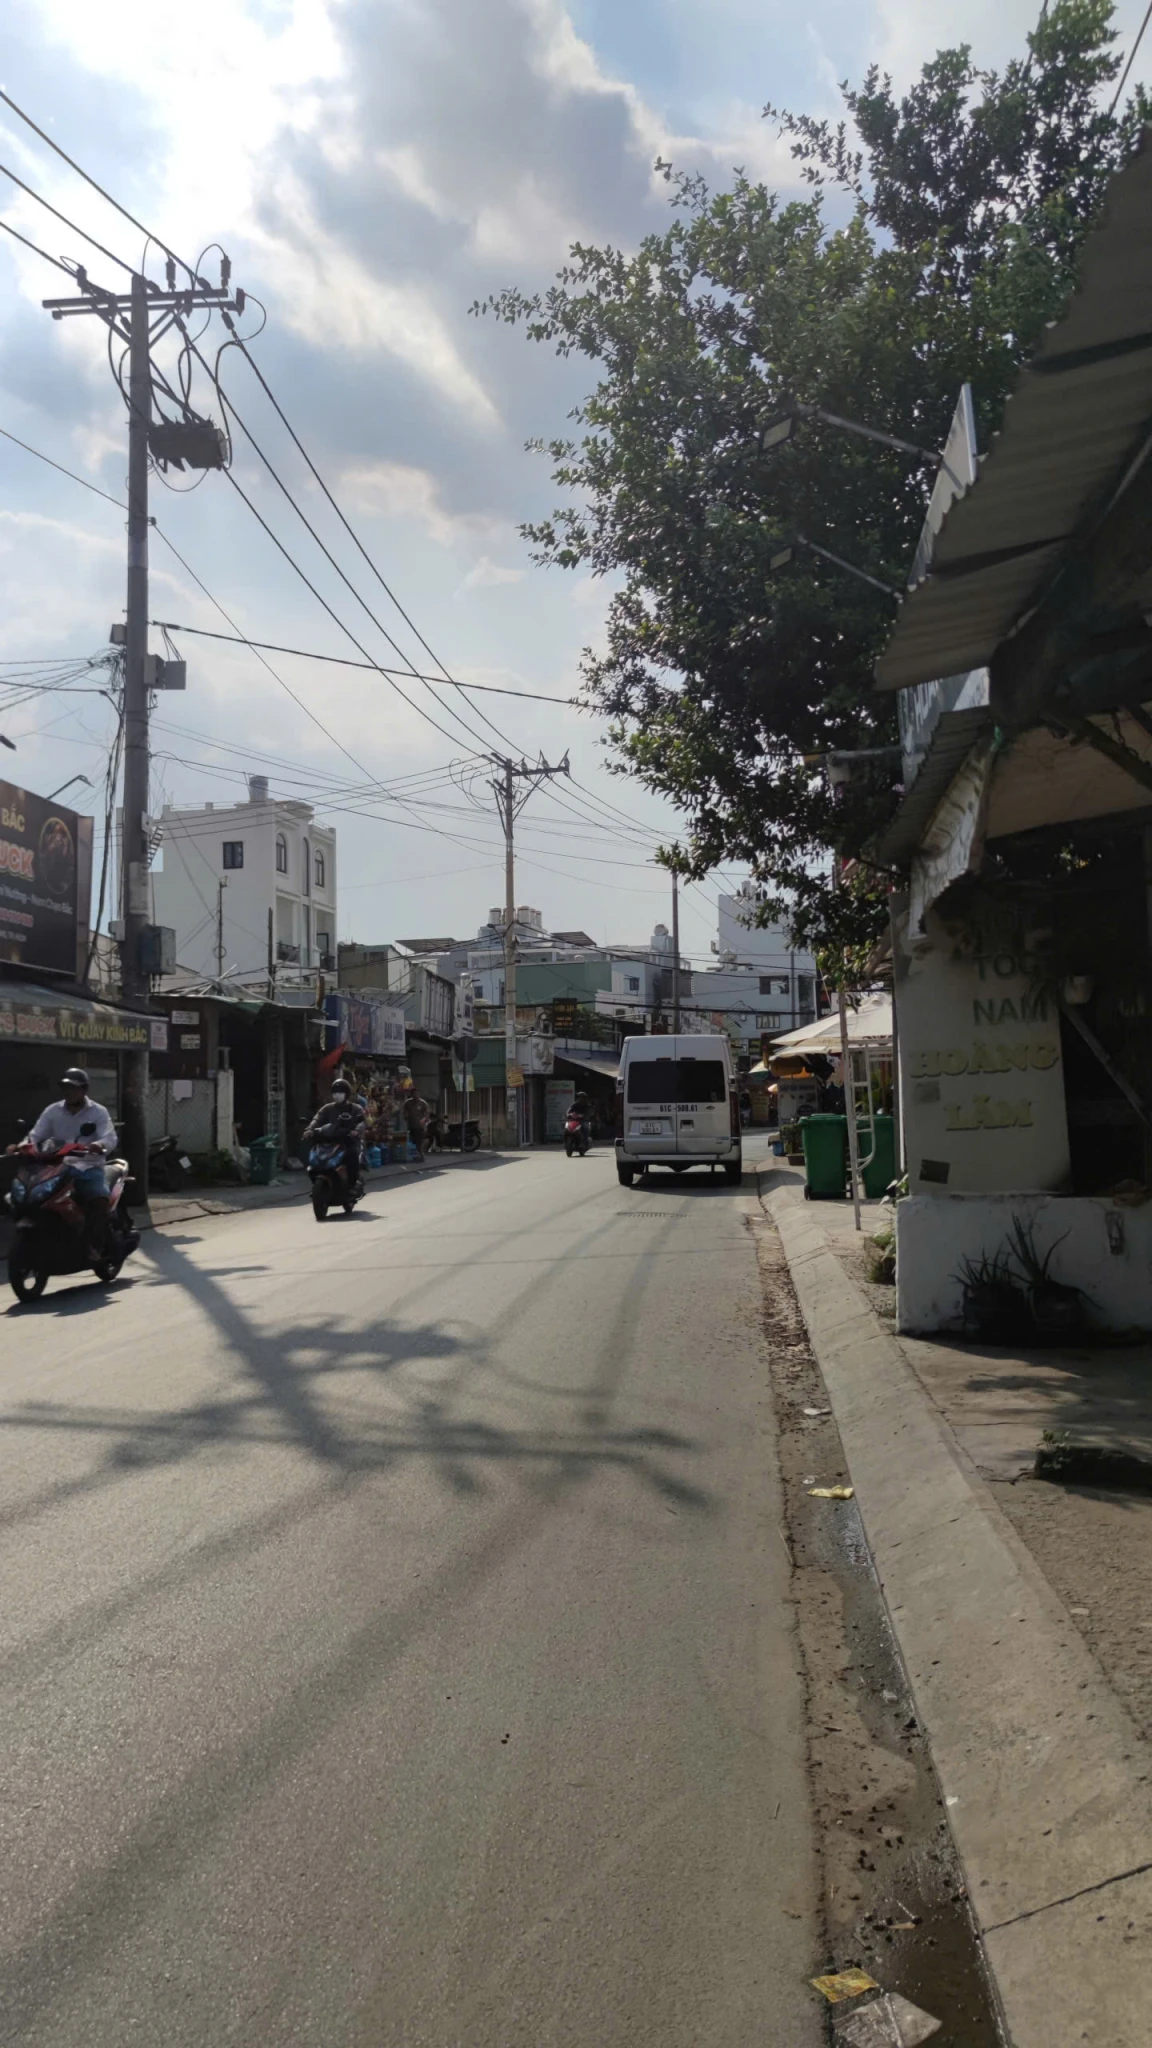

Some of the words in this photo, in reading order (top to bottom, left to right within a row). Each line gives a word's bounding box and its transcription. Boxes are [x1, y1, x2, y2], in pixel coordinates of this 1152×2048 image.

[1, 802, 26, 833] BẮC
[973, 996, 1049, 1025] NAM
[78, 1023, 105, 1041] QUAY
[106, 1025, 129, 1042] KINH
